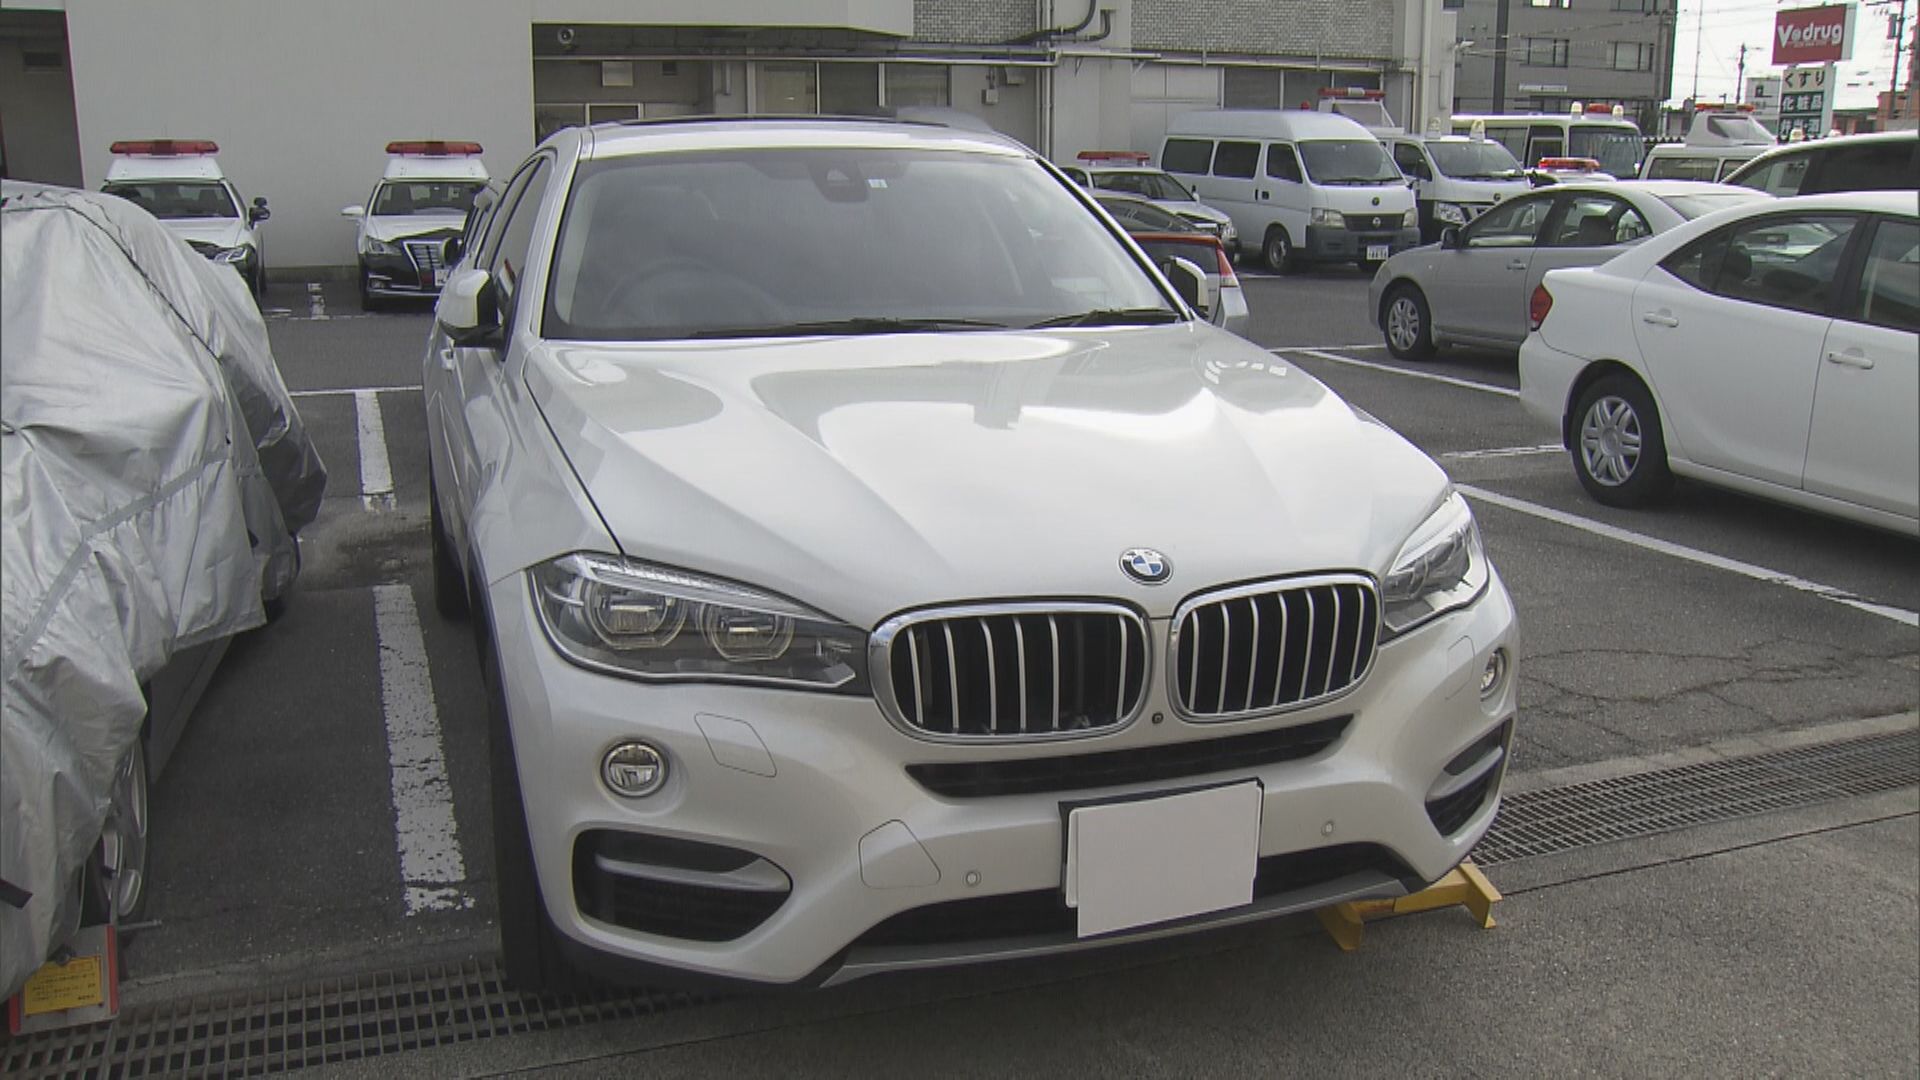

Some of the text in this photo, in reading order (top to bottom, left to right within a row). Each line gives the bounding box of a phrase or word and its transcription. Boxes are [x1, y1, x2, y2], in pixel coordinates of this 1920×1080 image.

[1785, 70, 1825, 88] くすり
[1782, 94, 1823, 112] 化粧品
